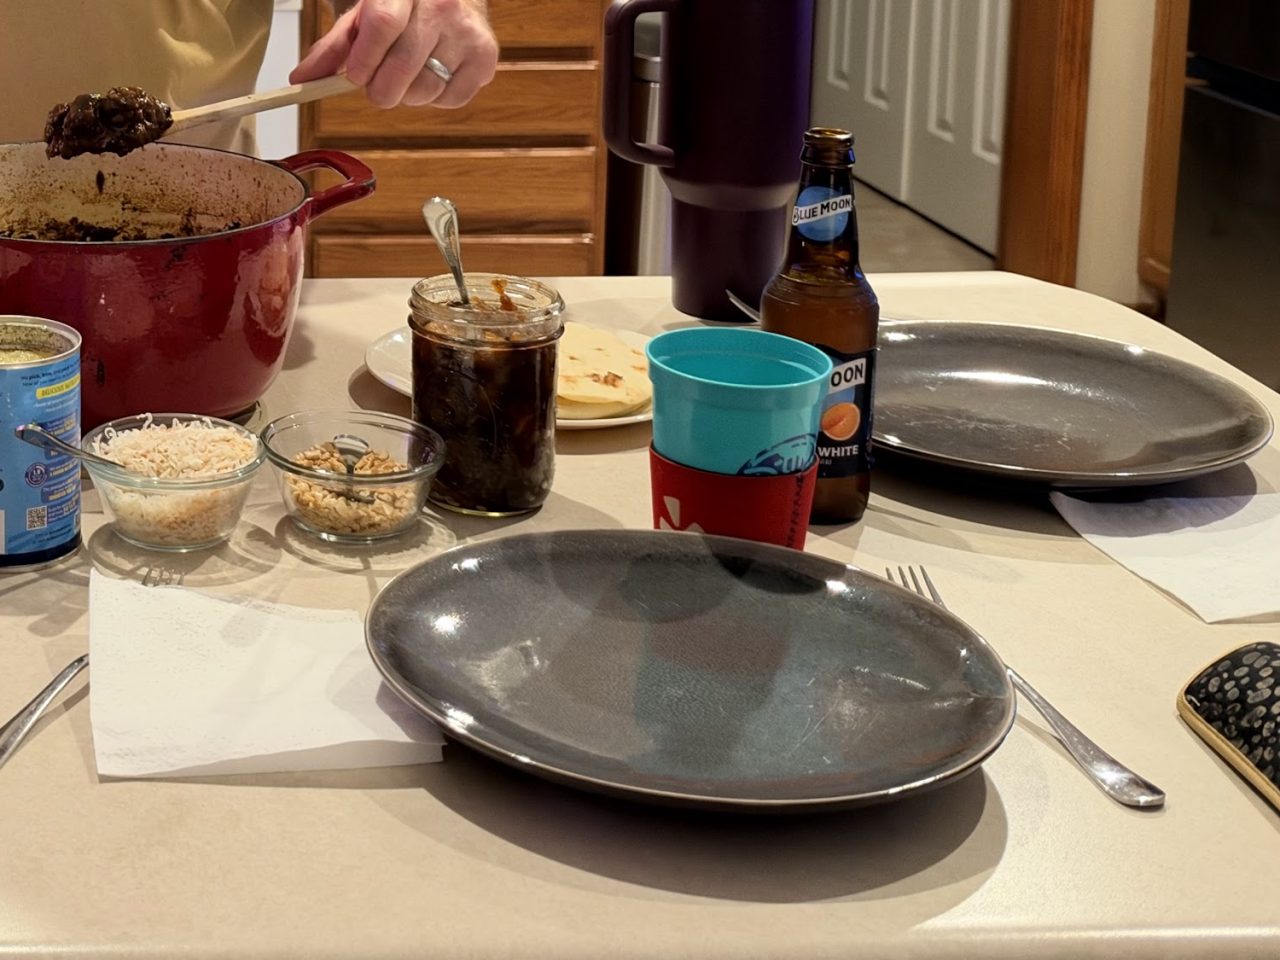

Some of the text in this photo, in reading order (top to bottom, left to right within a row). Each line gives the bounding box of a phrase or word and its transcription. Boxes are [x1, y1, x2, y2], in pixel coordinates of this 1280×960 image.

[792, 197, 851, 224] BLUE MOON
[830, 362, 864, 387] OON
[817, 444, 860, 458] WHITE
